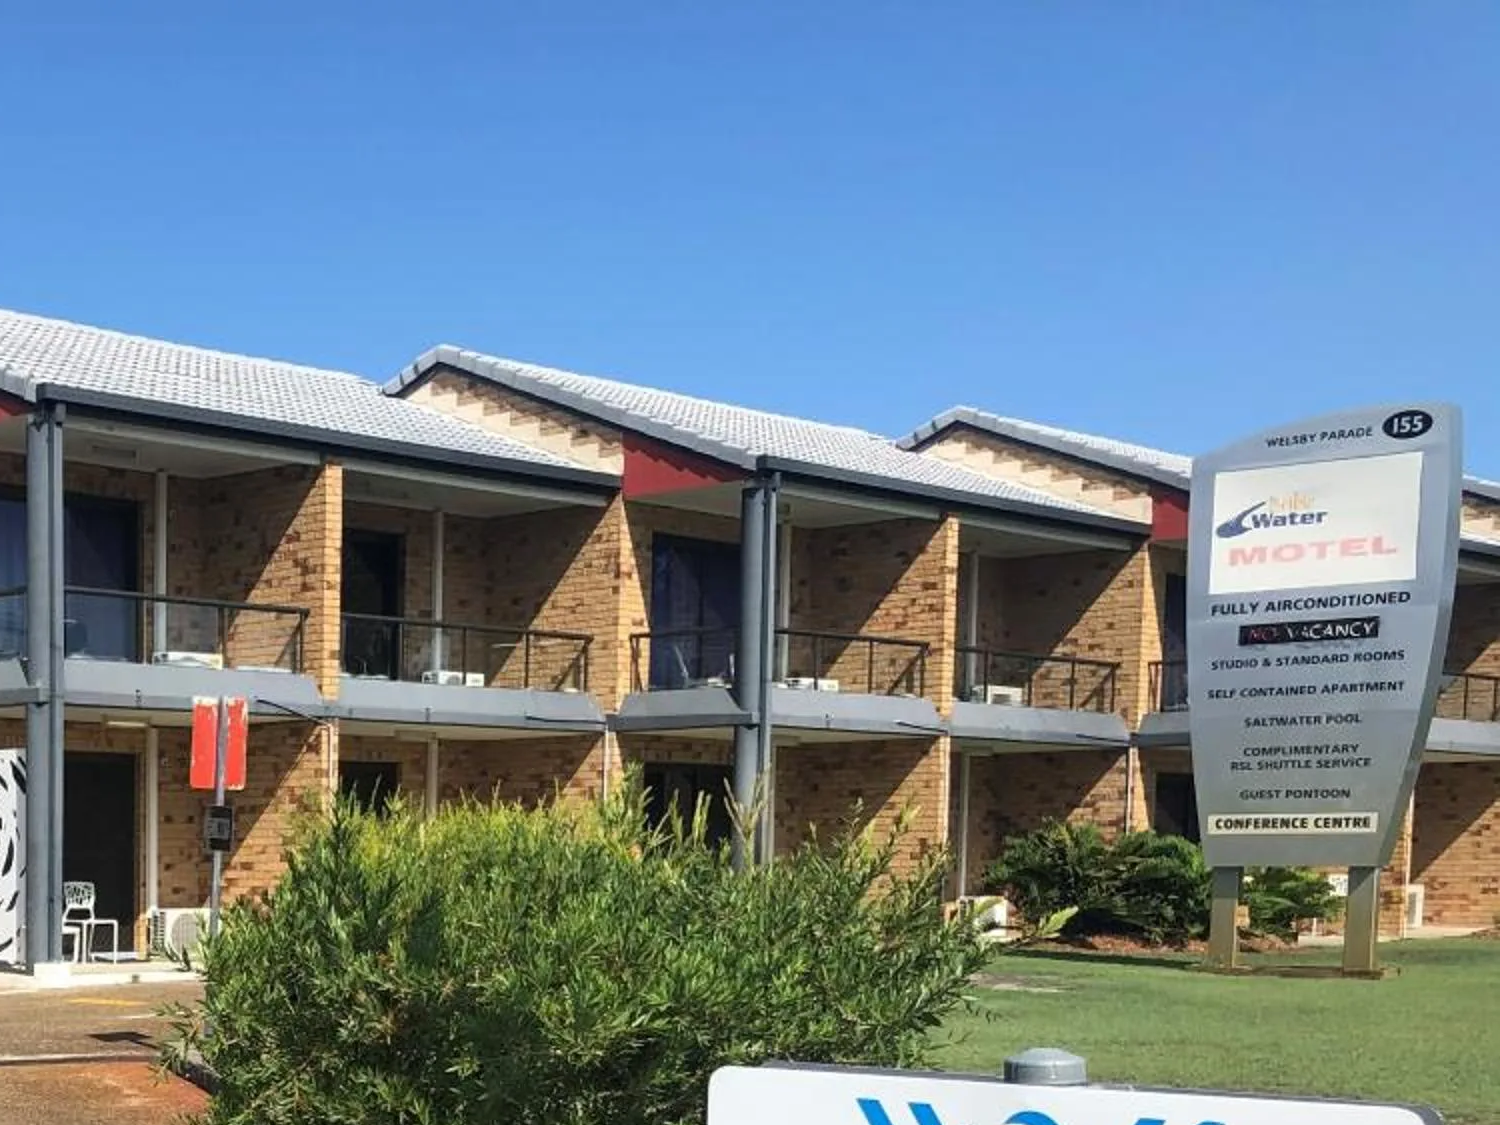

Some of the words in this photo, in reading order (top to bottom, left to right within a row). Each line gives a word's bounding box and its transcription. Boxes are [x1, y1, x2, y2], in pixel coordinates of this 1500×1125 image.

[1266, 434, 1317, 448] WELSBY
[1320, 427, 1373, 441] PARADE
[1392, 415, 1424, 434] 155
[1251, 511, 1328, 529] Water
[1228, 535, 1398, 567] MOTEL
[1211, 603, 1259, 616] FULLY
[1265, 591, 1411, 612] AIRCONDITIONED
[1211, 659, 1258, 671] STUDIO
[1262, 656, 1271, 667] &
[1276, 653, 1349, 667] STANDARD
[1353, 649, 1405, 662] ROOMS
[1208, 689, 1236, 699] SELF
[1240, 685, 1317, 698] CONTAINED
[1321, 681, 1405, 694] APARTMENT
[1244, 716, 1321, 728] SALTWATER
[1325, 713, 1362, 725] POOL
[1243, 744, 1359, 757] COMPLIMENTARY
[1256, 759, 1311, 771] SHUTTLE
[1315, 757, 1372, 769] SERVICE
[1239, 789, 1282, 801] GUEST
[1285, 788, 1351, 800] PONTOON
[1215, 818, 1308, 830] CONFERENCE
[1313, 816, 1371, 829] CENTRE
